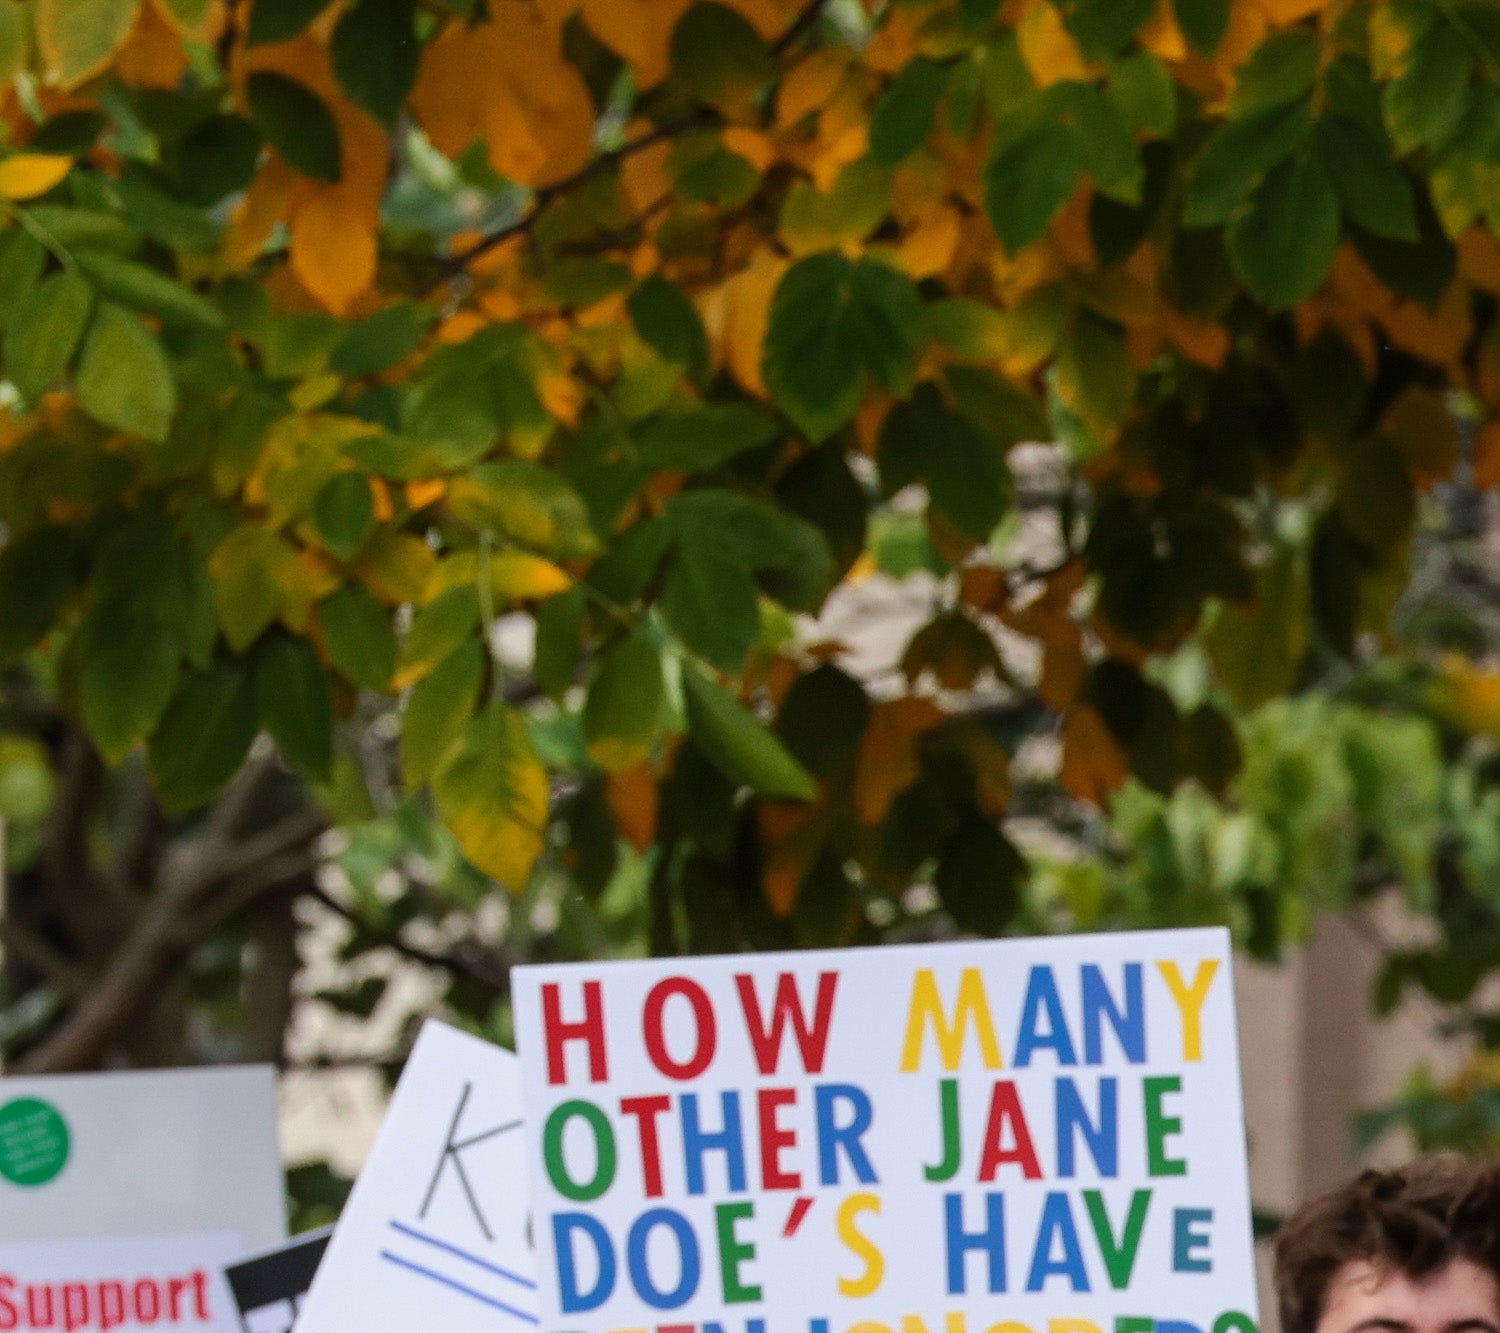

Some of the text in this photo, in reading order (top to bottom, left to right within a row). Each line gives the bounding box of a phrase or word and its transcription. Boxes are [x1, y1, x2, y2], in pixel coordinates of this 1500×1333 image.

[540, 958, 1222, 1085] HOW MANY
[541, 1075, 1188, 1202] OTHER JANE
[550, 1188, 1214, 1314] DOE'S HAVE
